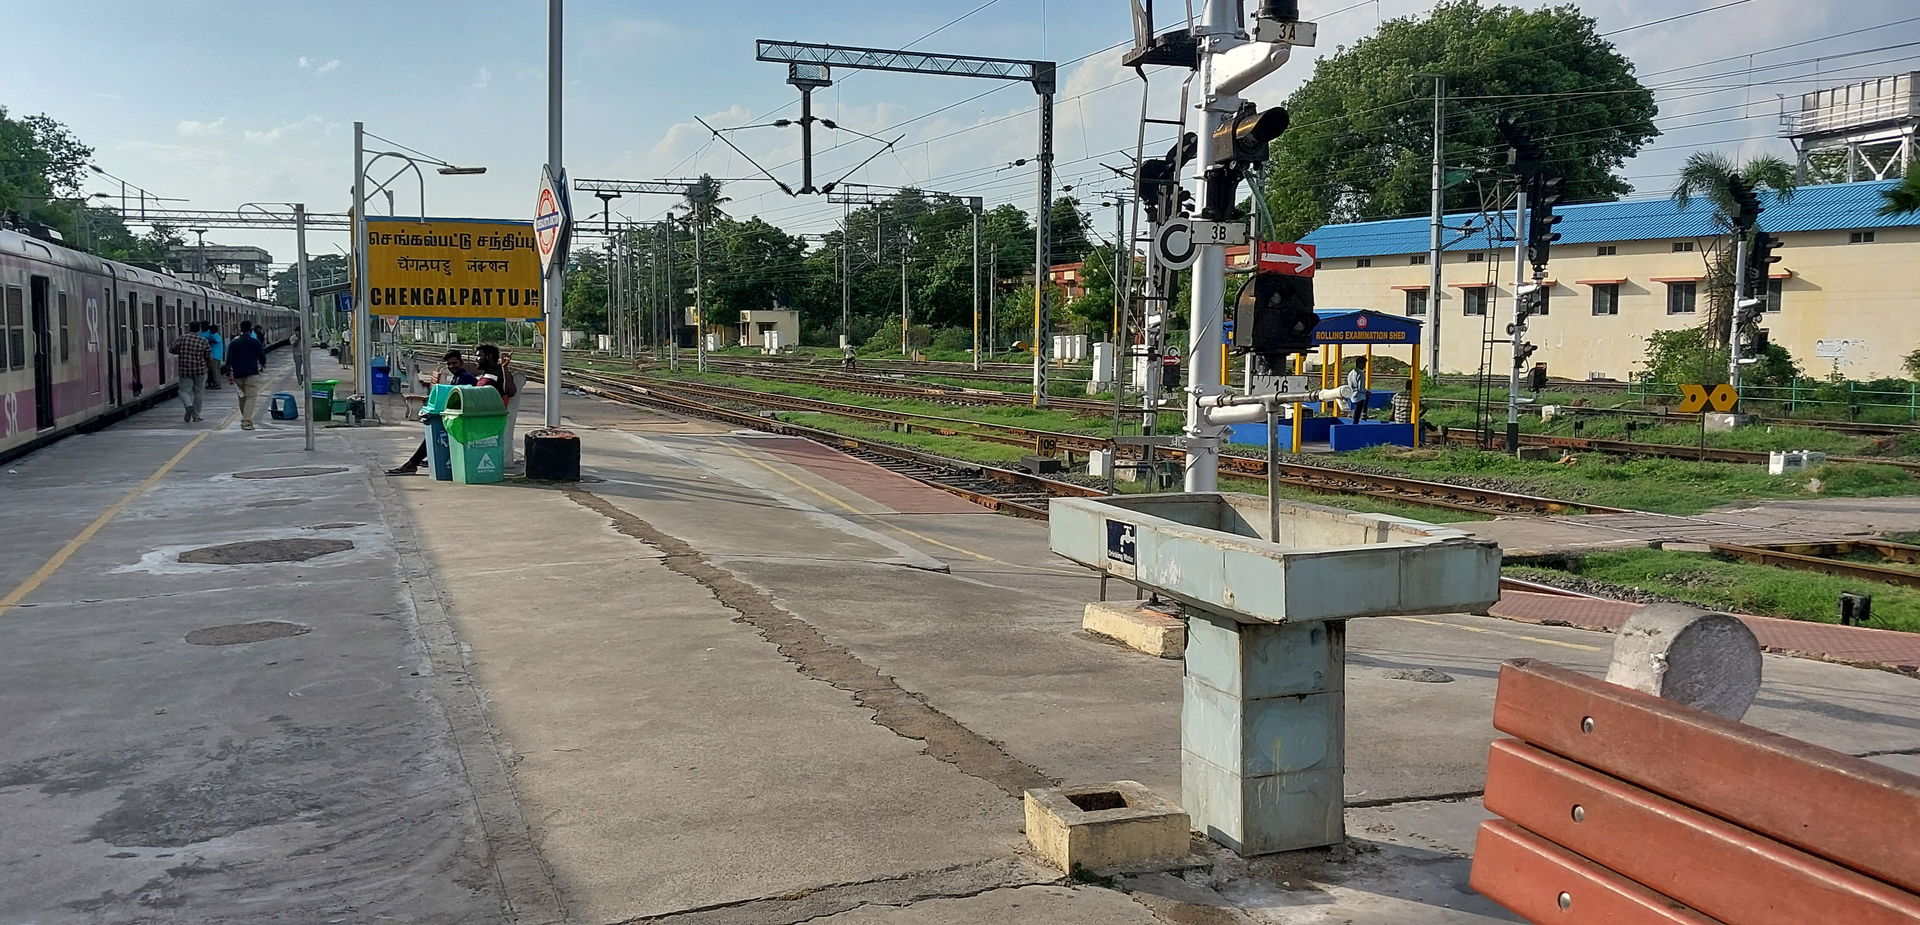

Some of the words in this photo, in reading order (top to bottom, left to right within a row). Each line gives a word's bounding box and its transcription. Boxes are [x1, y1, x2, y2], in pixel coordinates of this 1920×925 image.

[1279, 23, 1296, 41] 3A
[368, 229, 472, 250] செங்கல்பட்டு
[477, 230, 535, 252] சந்திப்பு
[1211, 225, 1227, 241] 3B
[466, 257, 510, 273] जंक्शन
[370, 287, 519, 307] CHENGALPATTU
[86, 297, 100, 353] SR
[1315, 331, 1344, 340] ROLLING
[1344, 331, 1388, 340] EXAMINATION
[1388, 331, 1406, 340] SHED
[1274, 379, 1289, 393] 16
[5, 392, 18, 438] SR
[1040, 438, 1056, 450] 109
